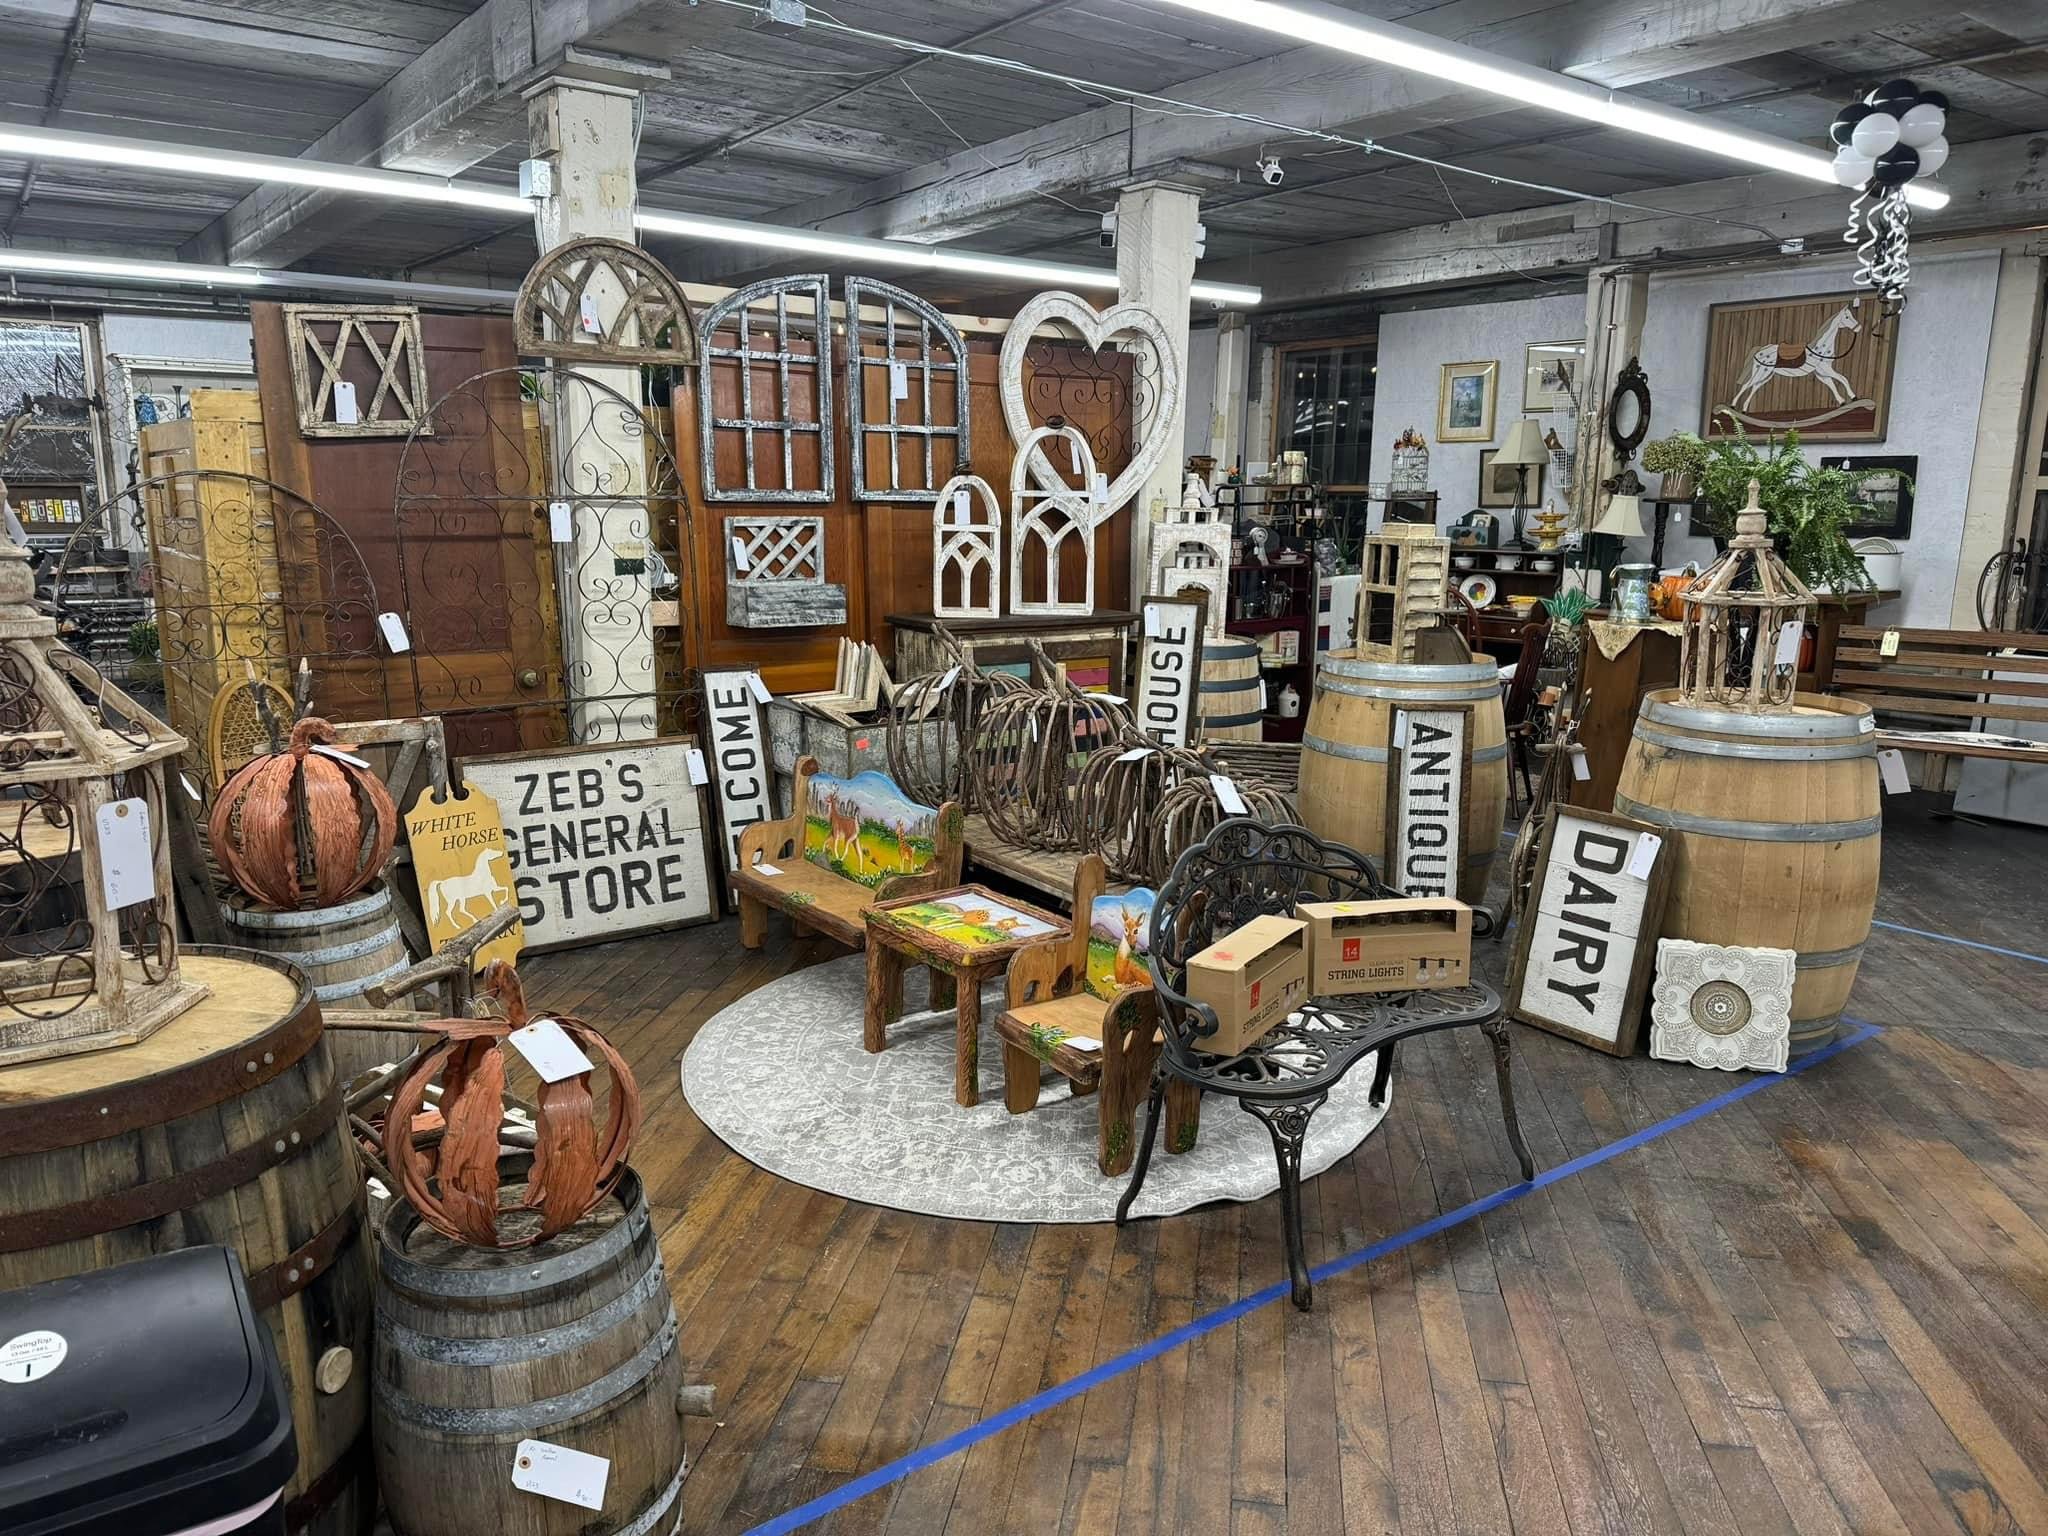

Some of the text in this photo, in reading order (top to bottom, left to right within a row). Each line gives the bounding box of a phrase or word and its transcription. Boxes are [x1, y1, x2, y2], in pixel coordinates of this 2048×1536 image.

[21, 504, 80, 518] ROOSTER
[514, 758, 644, 816] ZEB'S
[712, 686, 766, 856] LCOME
[411, 811, 477, 837] WHITE
[441, 827, 499, 852] HORSE
[503, 807, 685, 870] GENERAL
[1405, 722, 1453, 898] ANTIQUE
[513, 854, 686, 926] STORE
[1547, 829, 1630, 1016] DAIRY
[1328, 968, 1366, 981] STRING
[1368, 966, 1404, 978] LIGHTS
